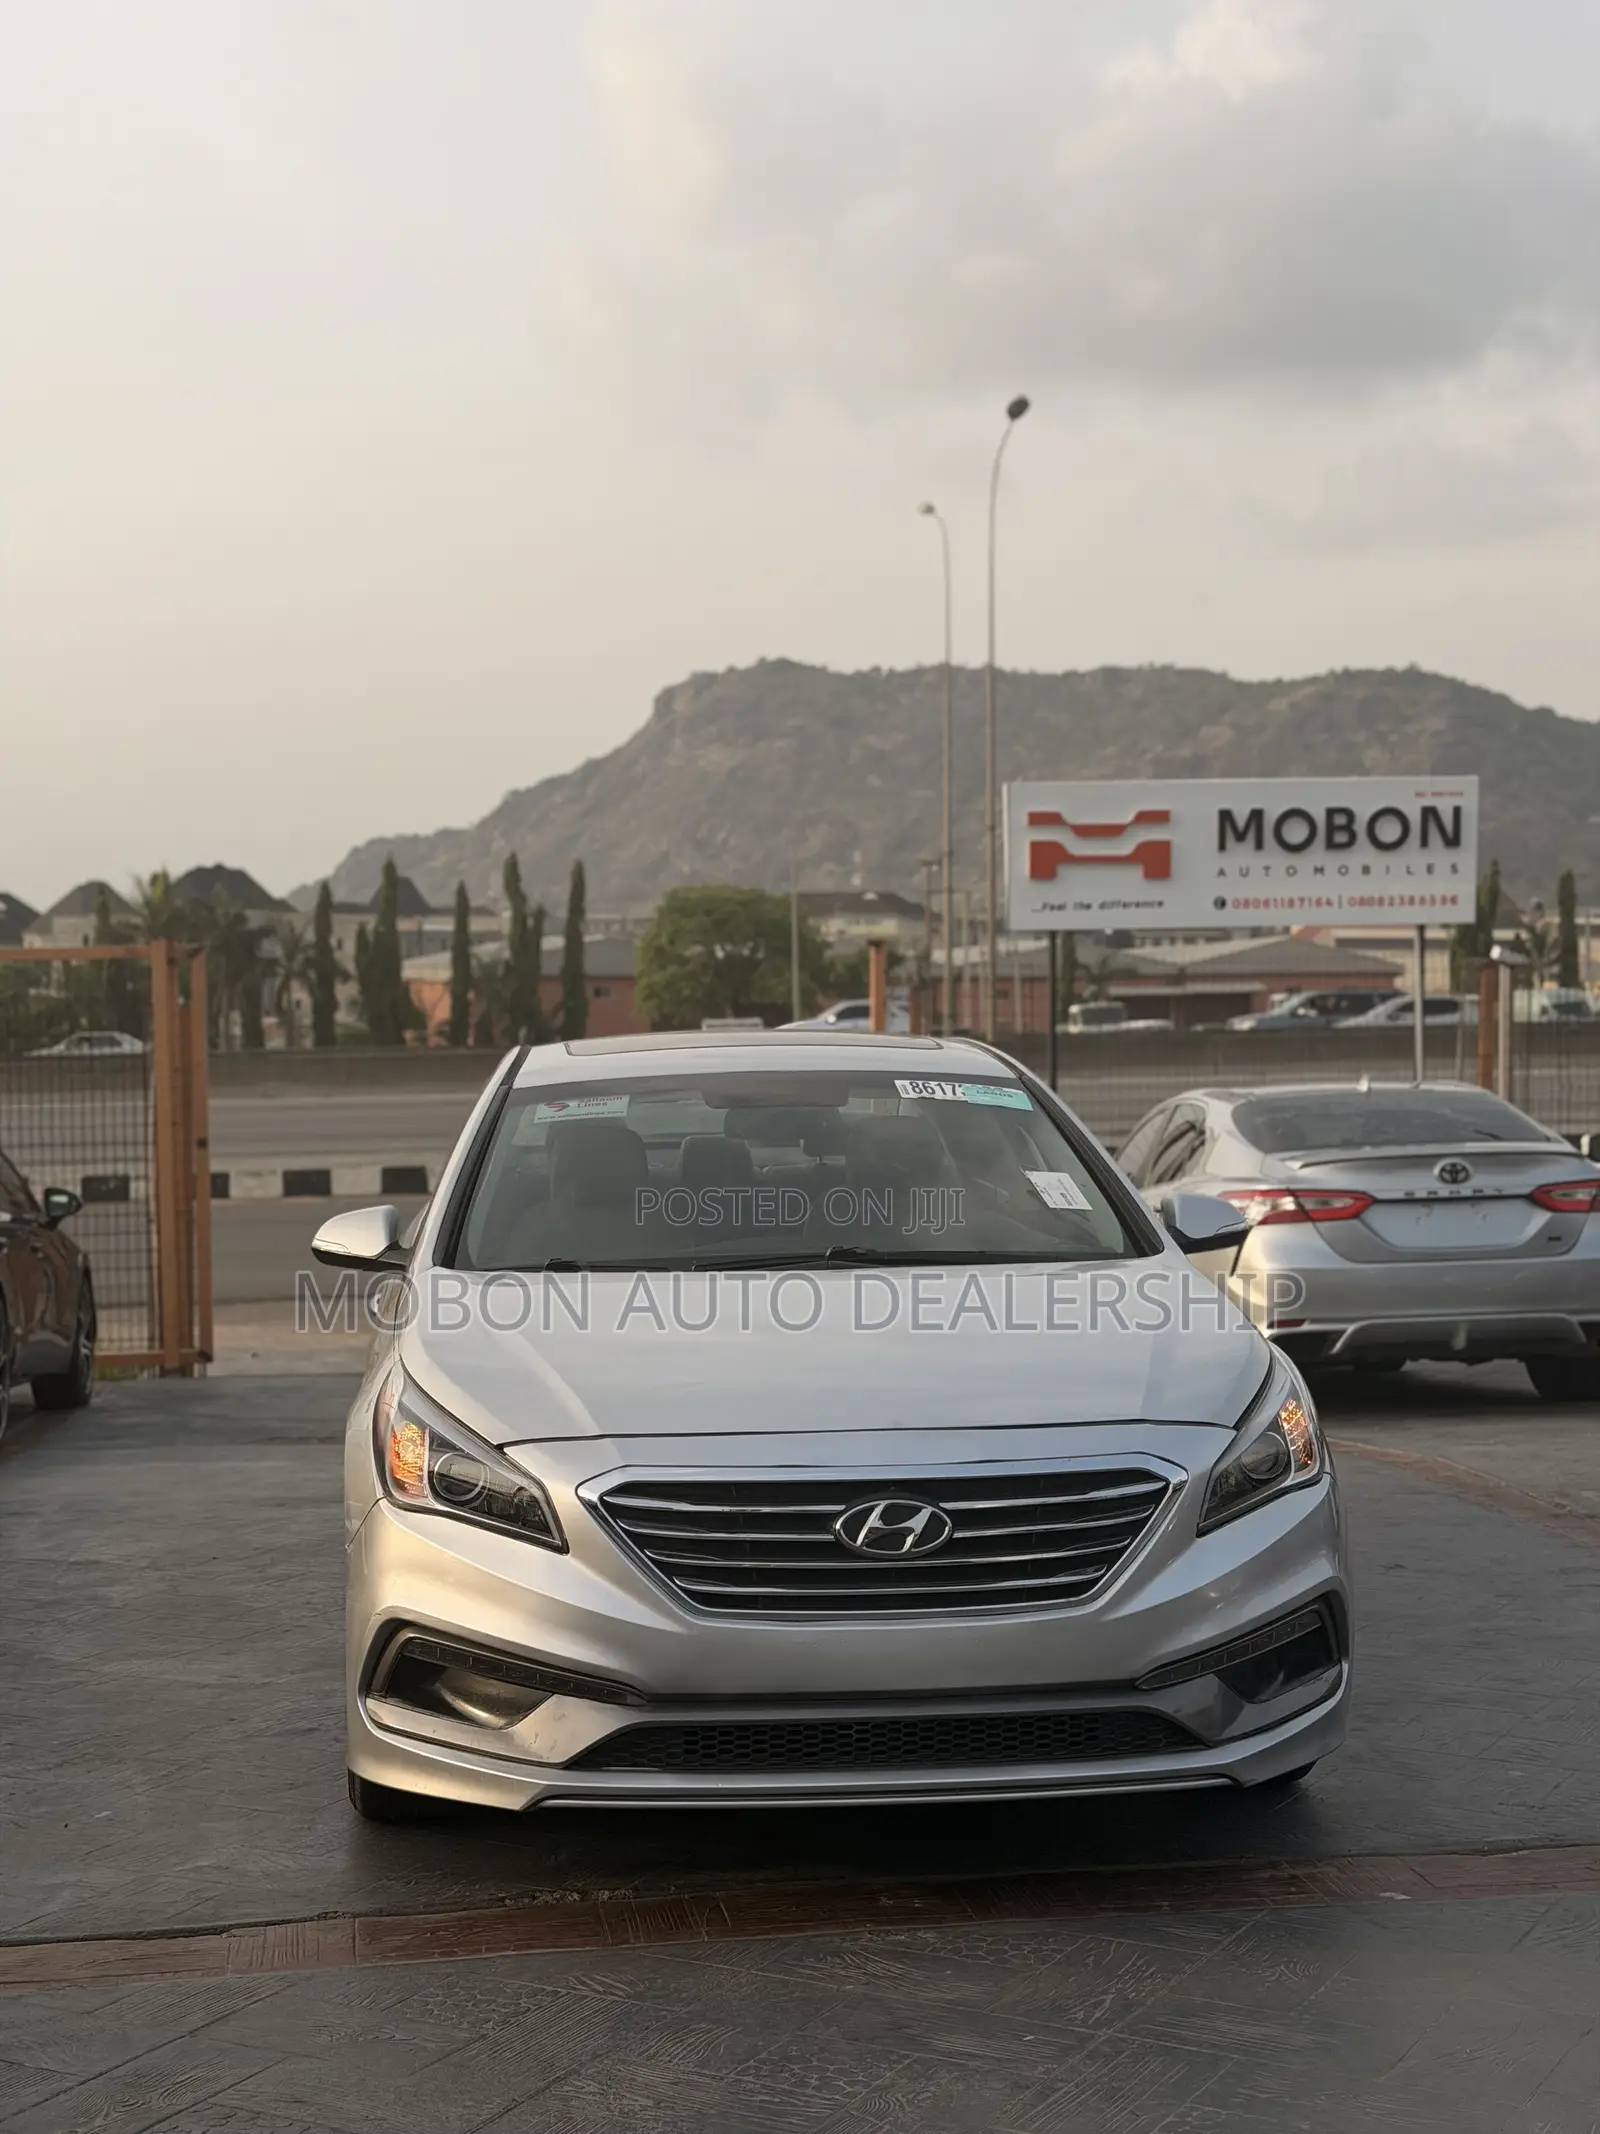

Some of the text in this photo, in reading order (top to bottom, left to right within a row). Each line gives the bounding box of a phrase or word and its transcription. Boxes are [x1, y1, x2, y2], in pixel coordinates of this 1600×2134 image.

[1217, 805, 1463, 853] MOBON
[1216, 862, 1460, 878] AUTOMOBILES
[1072, 901, 1092, 912] the
[1098, 899, 1165, 911] difference
